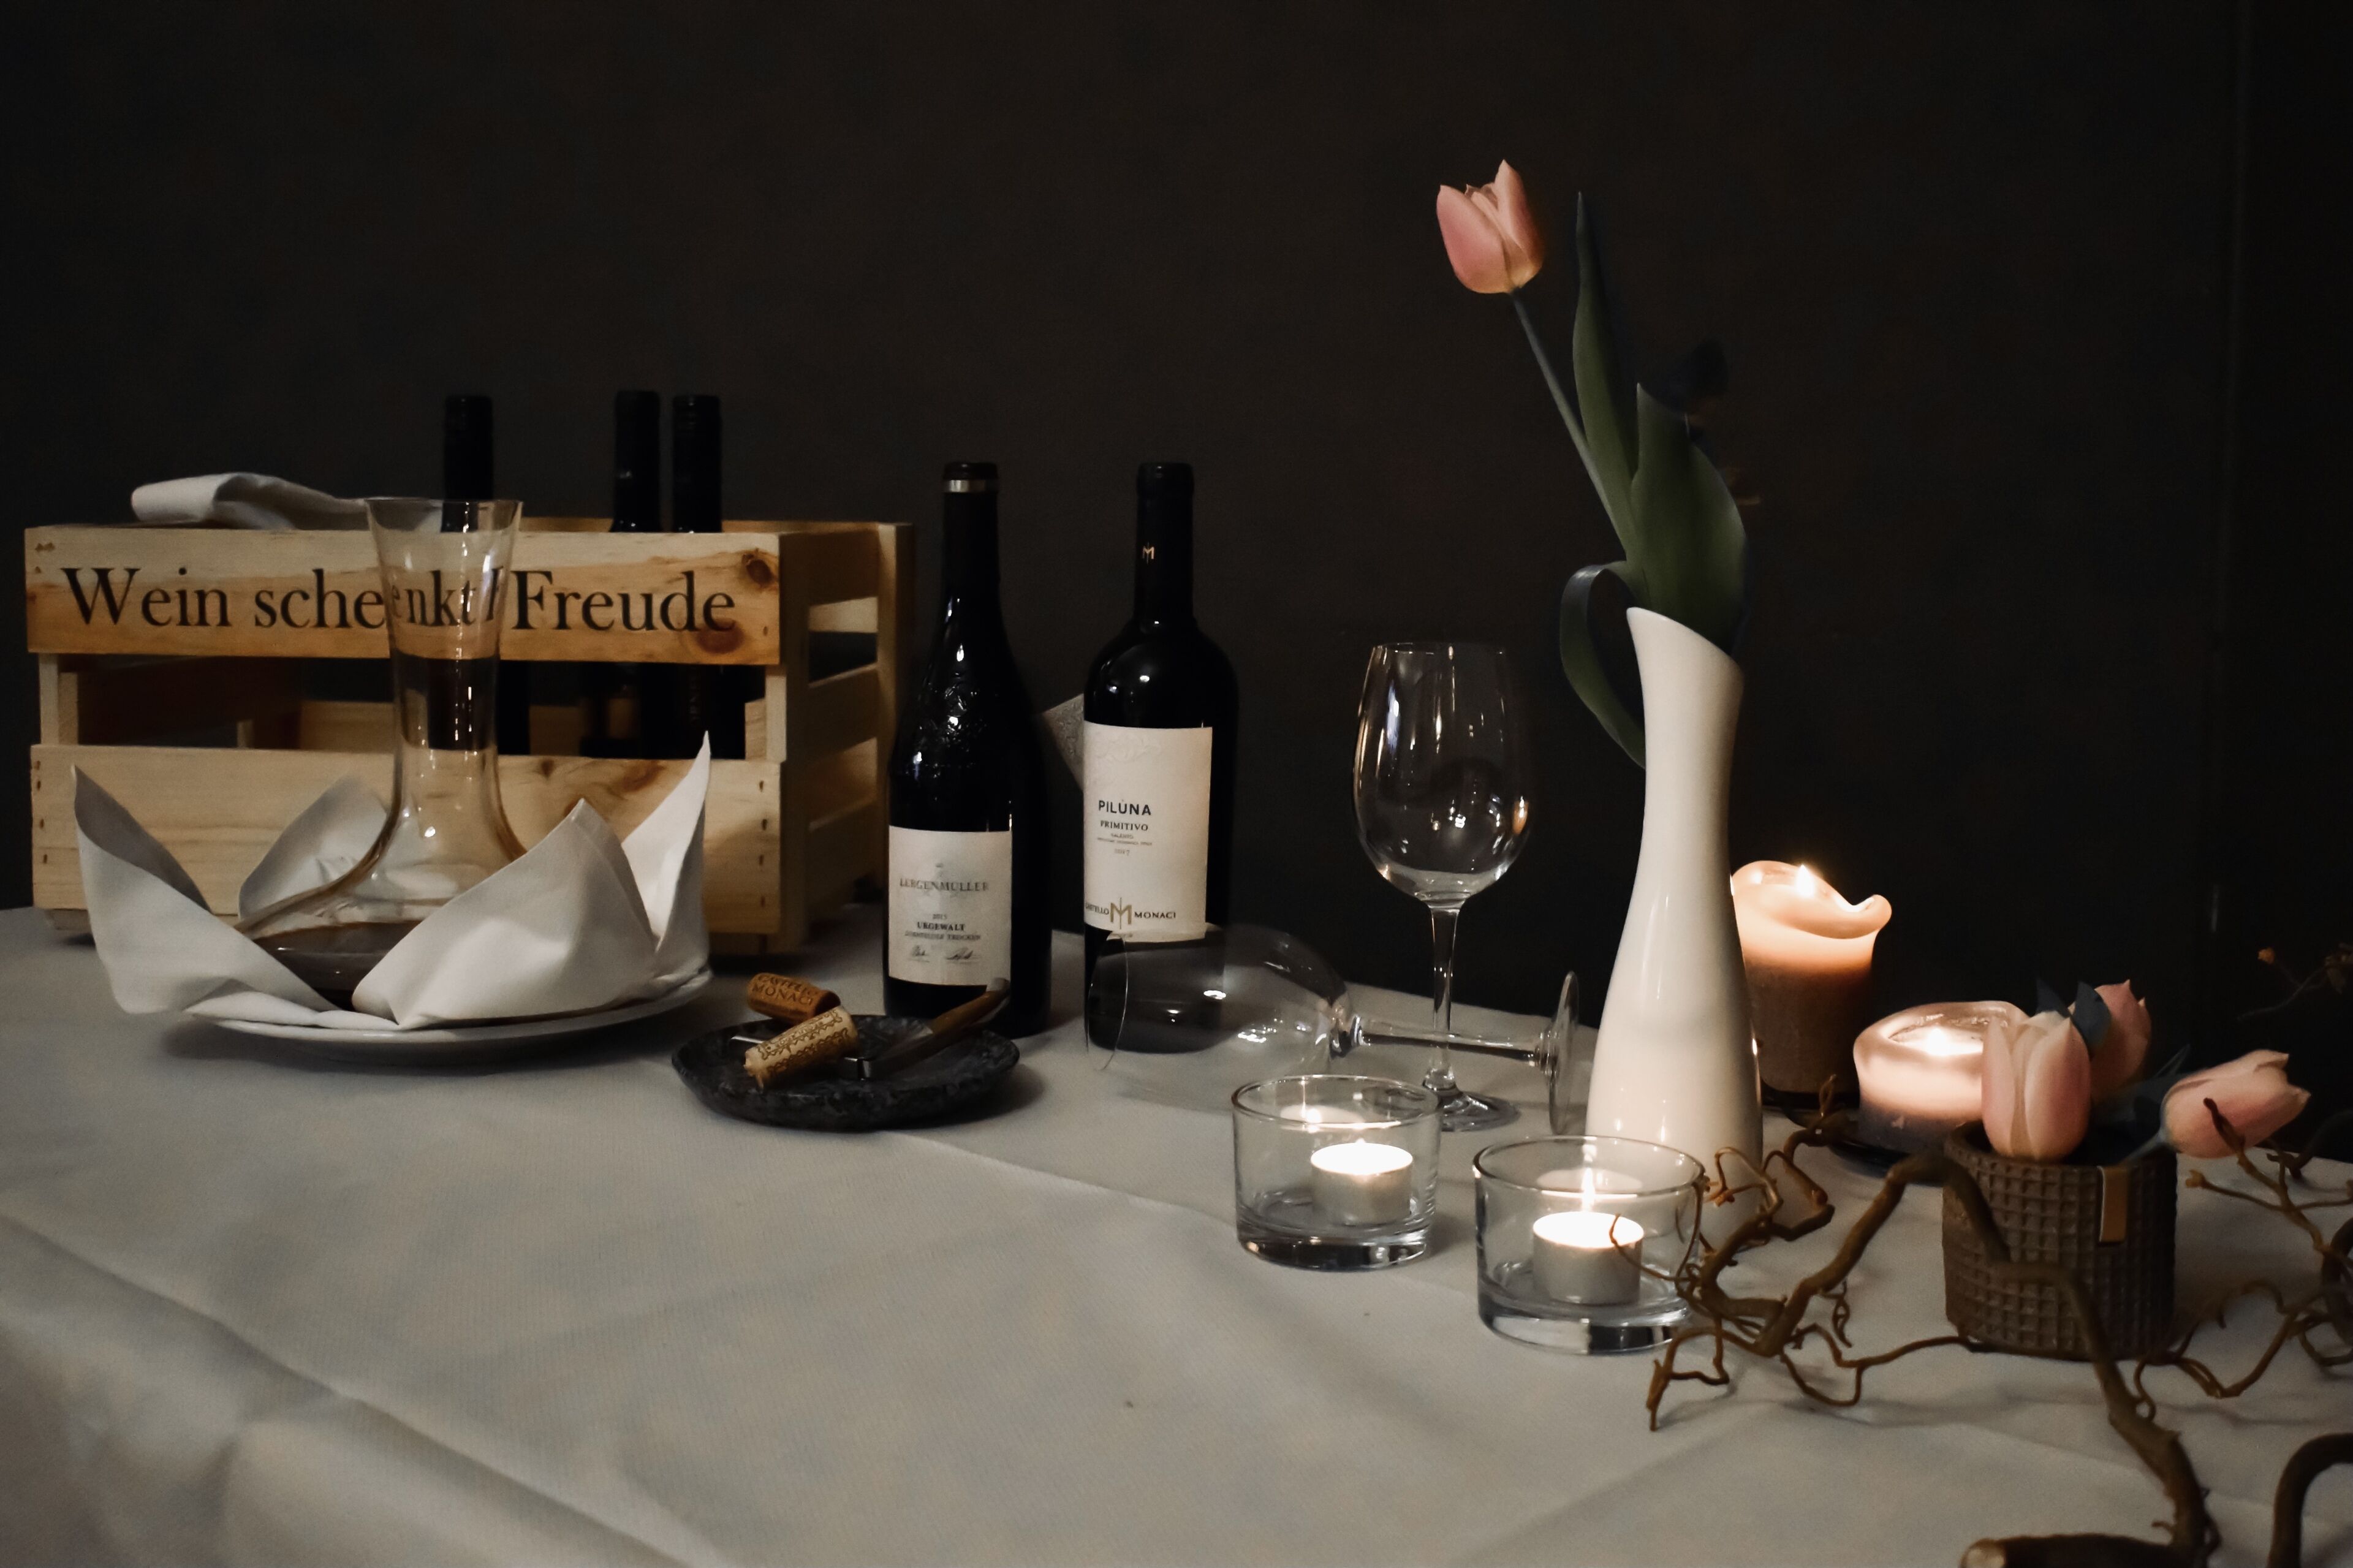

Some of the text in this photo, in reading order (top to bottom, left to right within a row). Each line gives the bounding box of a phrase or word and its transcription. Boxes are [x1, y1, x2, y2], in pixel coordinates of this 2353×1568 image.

[61, 567, 735, 632] Wein schenkt Freude
[1101, 820, 1148, 831] PRIMITIVO
[1134, 911, 1176, 920] MONACI
[752, 982, 814, 1006] MONACI
